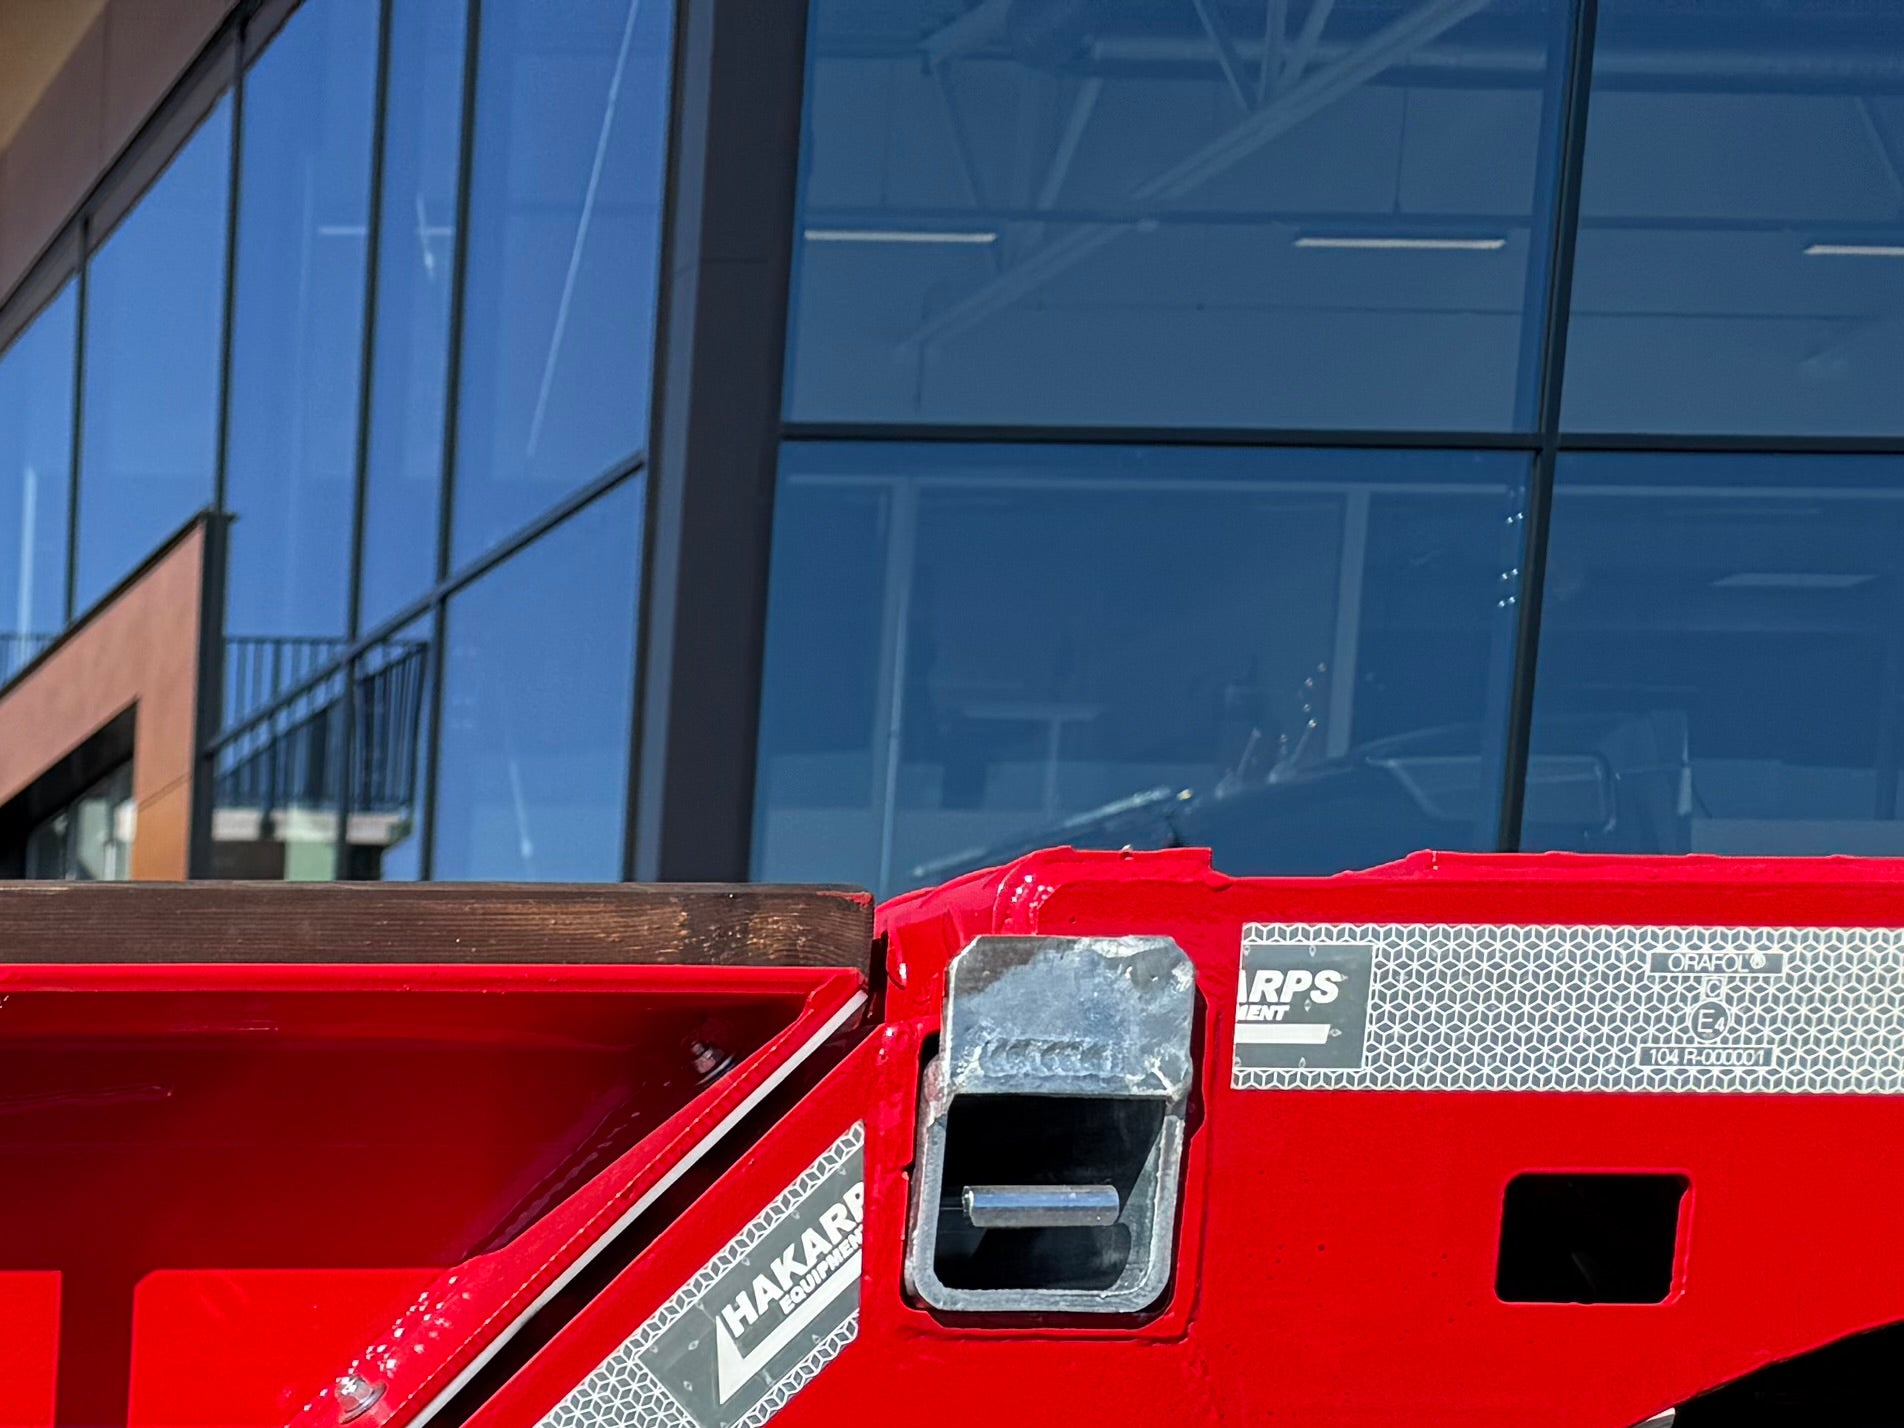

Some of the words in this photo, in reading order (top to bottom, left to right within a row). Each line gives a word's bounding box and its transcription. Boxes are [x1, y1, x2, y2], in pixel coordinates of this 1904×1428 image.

[1649, 1047, 1679, 1065] 104
[1683, 1047, 1765, 1066] R-000001
[777, 1223, 864, 1316] EQUIPMEN
